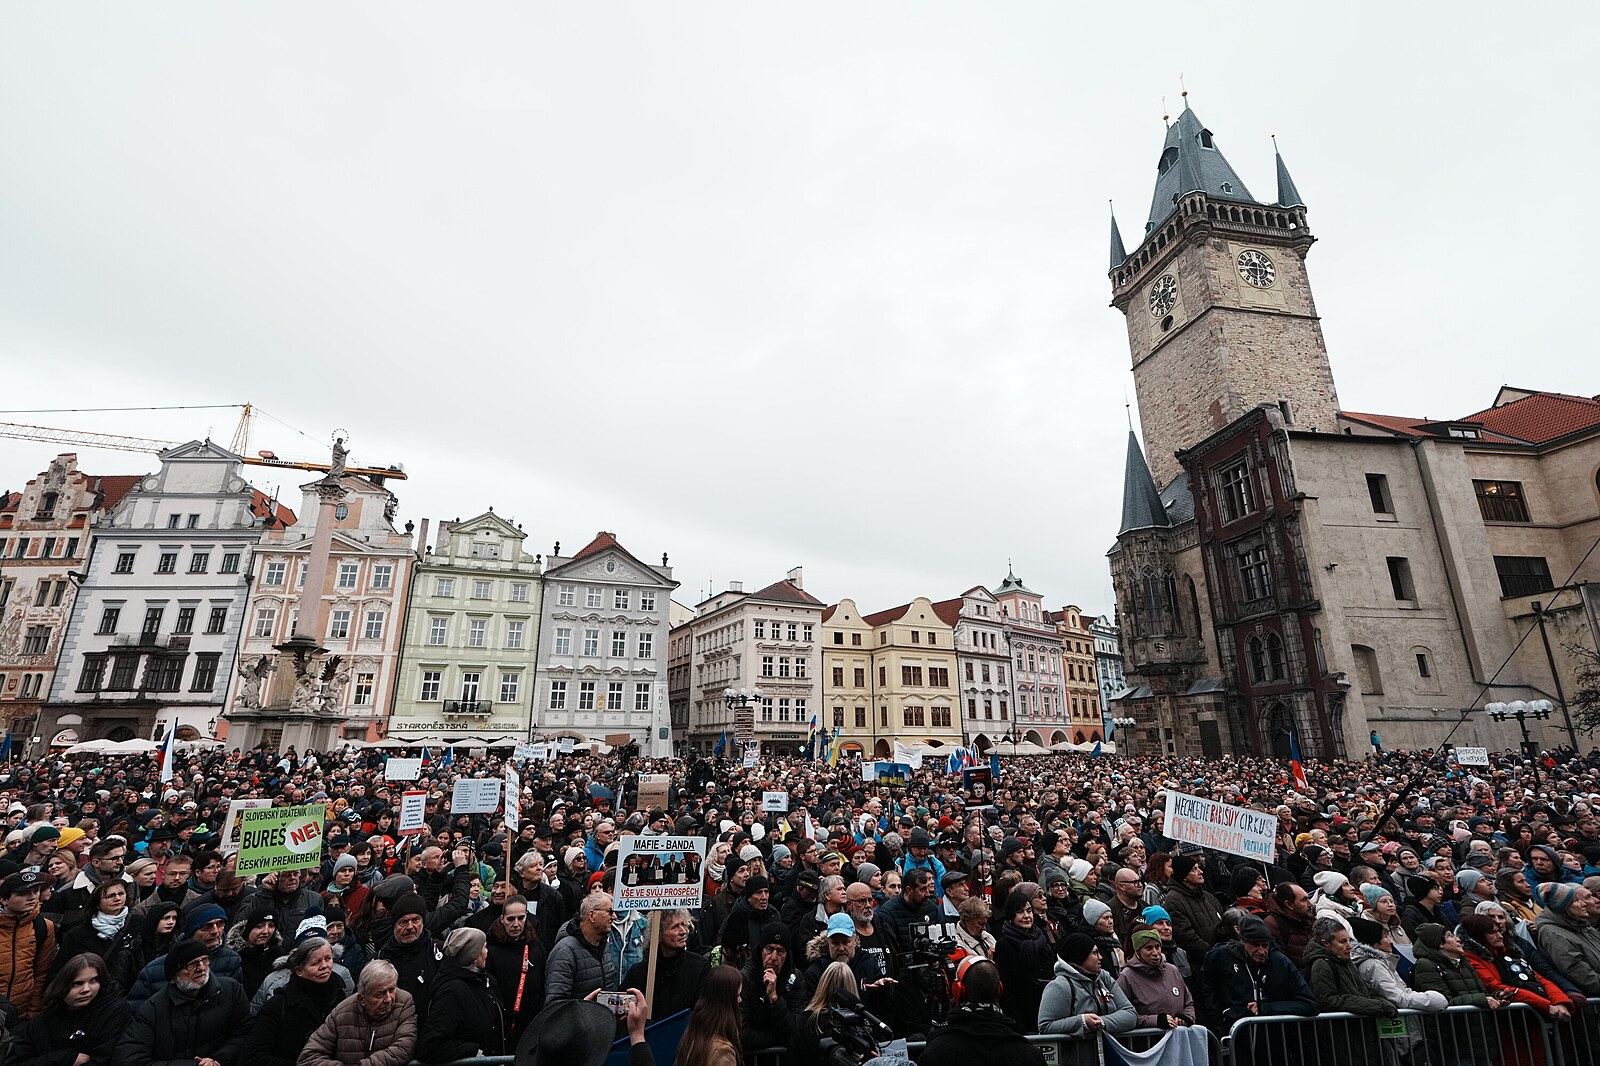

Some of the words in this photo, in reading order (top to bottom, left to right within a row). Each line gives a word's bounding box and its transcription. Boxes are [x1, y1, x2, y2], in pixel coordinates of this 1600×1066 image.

[396, 721, 468, 730] STAROMĚSTSKÁ
[245, 808, 280, 821] SLOVENSKÝ
[1175, 796, 1210, 821] NECHCEME
[243, 822, 286, 849] BUREŠ
[290, 821, 321, 846] NE!
[634, 840, 659, 849] MAFIE
[666, 840, 694, 849] BANDA
[239, 856, 270, 870] ČESKÝM
[272, 852, 320, 866] PREMIEREM?
[621, 888, 634, 896] VŠE
[646, 886, 662, 896] SVŮJ
[664, 886, 699, 896] PROSPĚCH
[625, 898, 650, 908] ČESKO,
[652, 898, 660, 907] AŽ
[680, 897, 699, 906] MÍSTĚ
